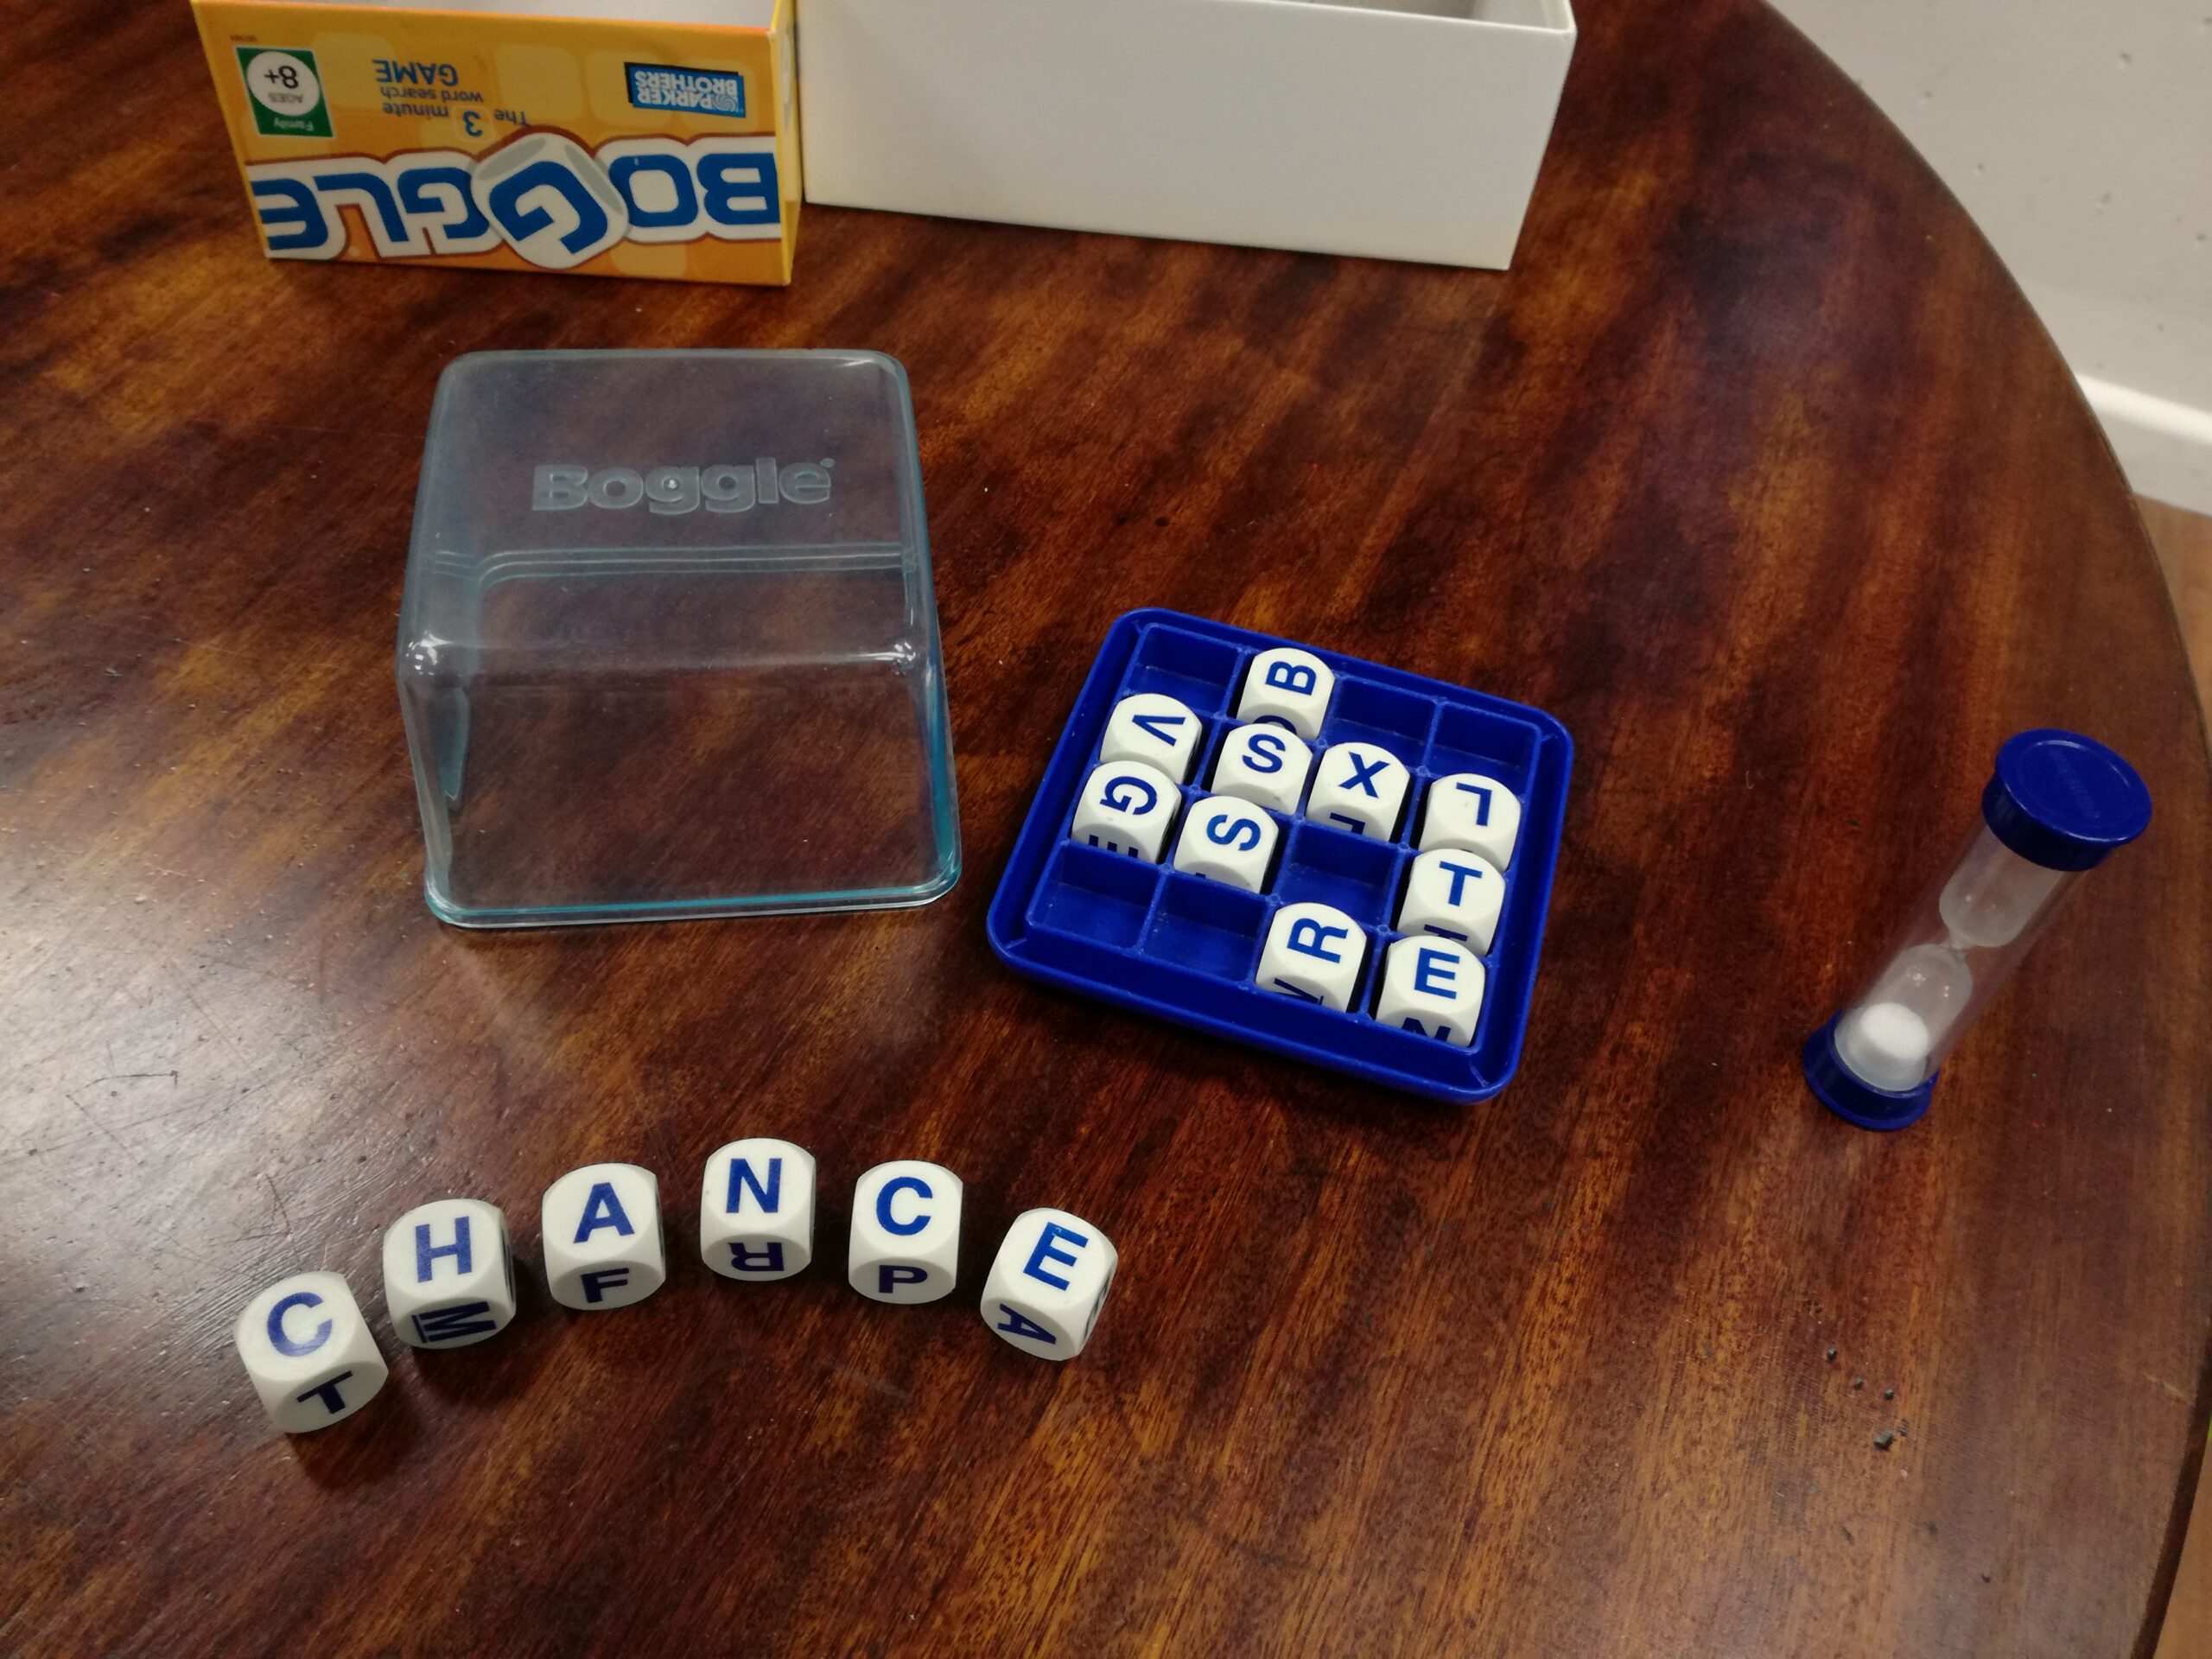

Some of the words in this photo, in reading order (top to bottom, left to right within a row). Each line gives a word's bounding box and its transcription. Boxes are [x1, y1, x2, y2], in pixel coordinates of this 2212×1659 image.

[264, 66, 299, 89] 8+
[372, 59, 459, 86] GAME
[634, 70, 738, 96] BROTHERS
[268, 92, 303, 104] AGES
[380, 86, 436, 100] search
[441, 89, 484, 104] word
[636, 87, 713, 110] PARKER
[383, 102, 449, 120] minute
[494, 109, 531, 126] The
[462, 111, 483, 137] 3
[252, 152, 783, 256] BOGGLE
[531, 457, 832, 515] Boggle
